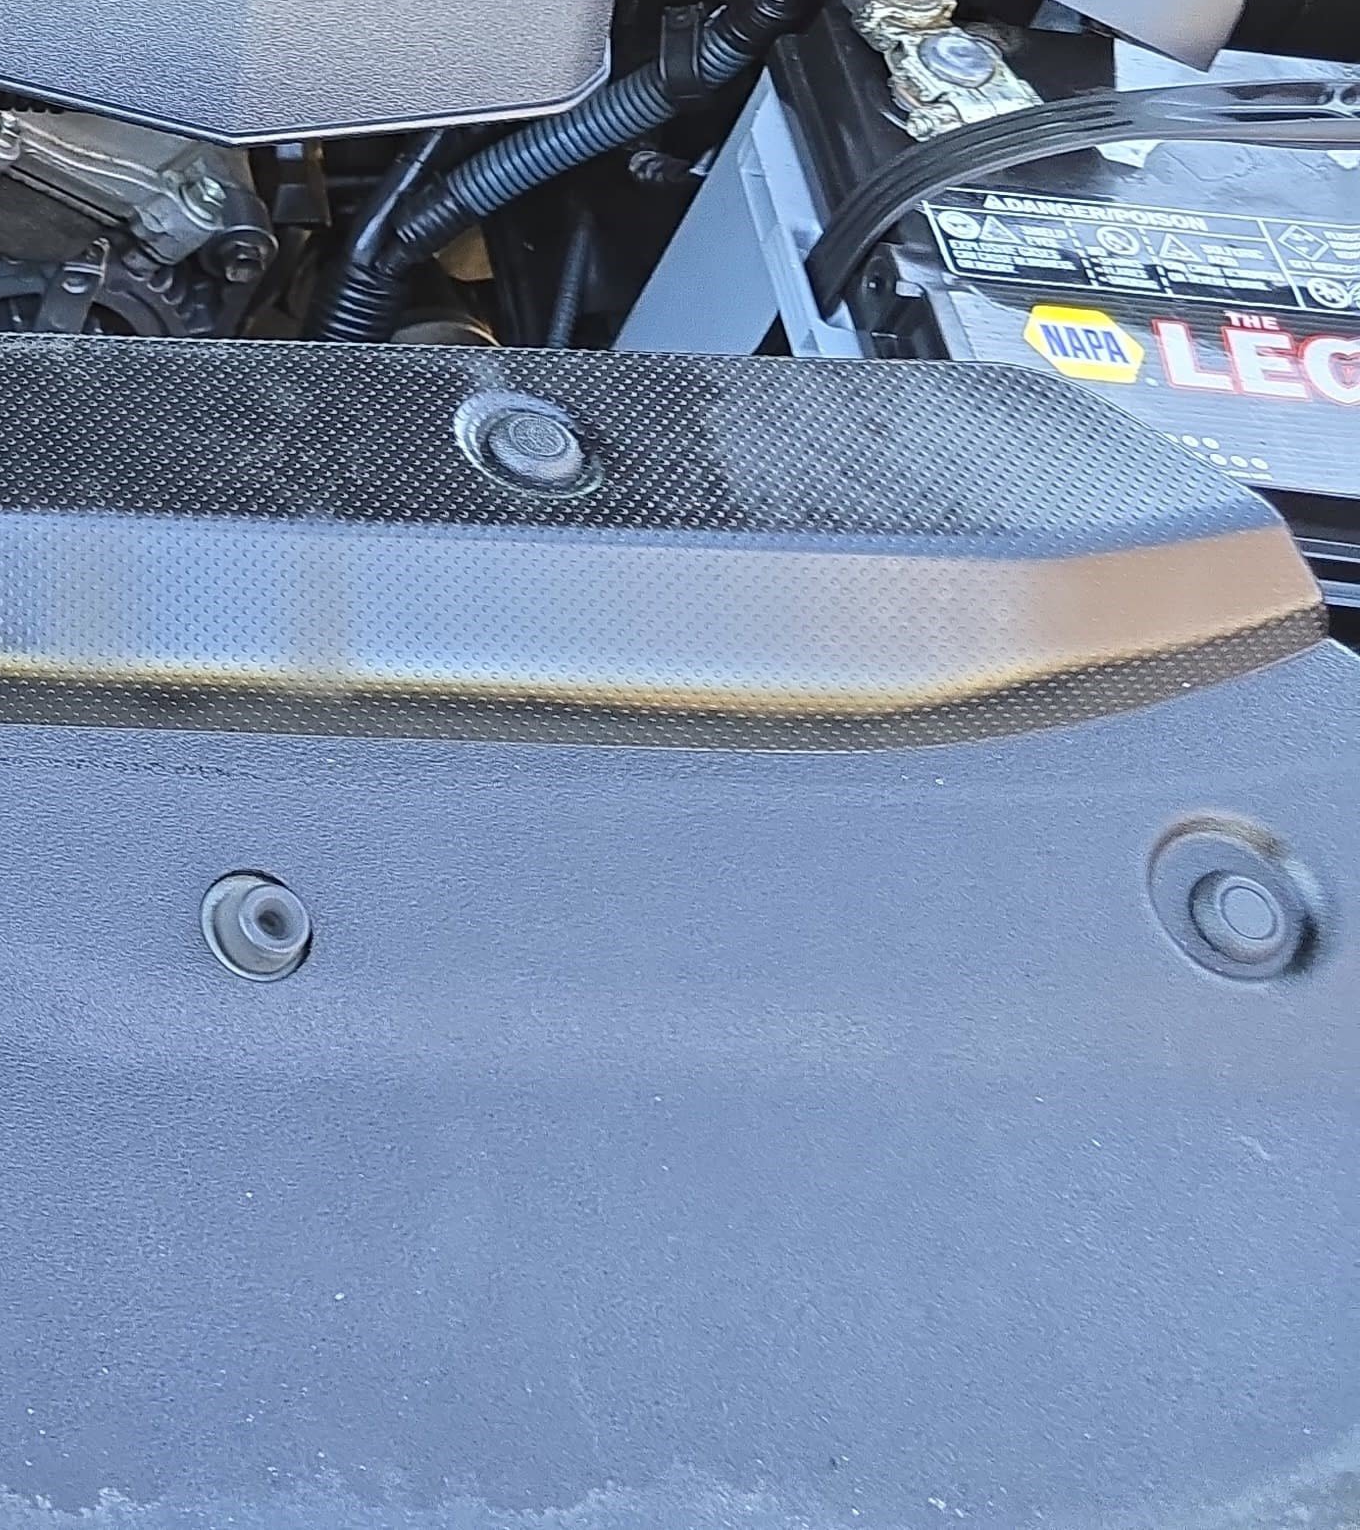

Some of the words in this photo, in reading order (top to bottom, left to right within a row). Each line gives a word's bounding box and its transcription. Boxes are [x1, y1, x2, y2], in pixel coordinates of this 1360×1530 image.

[1000, 197, 1209, 231] DANGER/POISON
[1224, 310, 1280, 329] THE
[1040, 324, 1130, 364] NAPA
